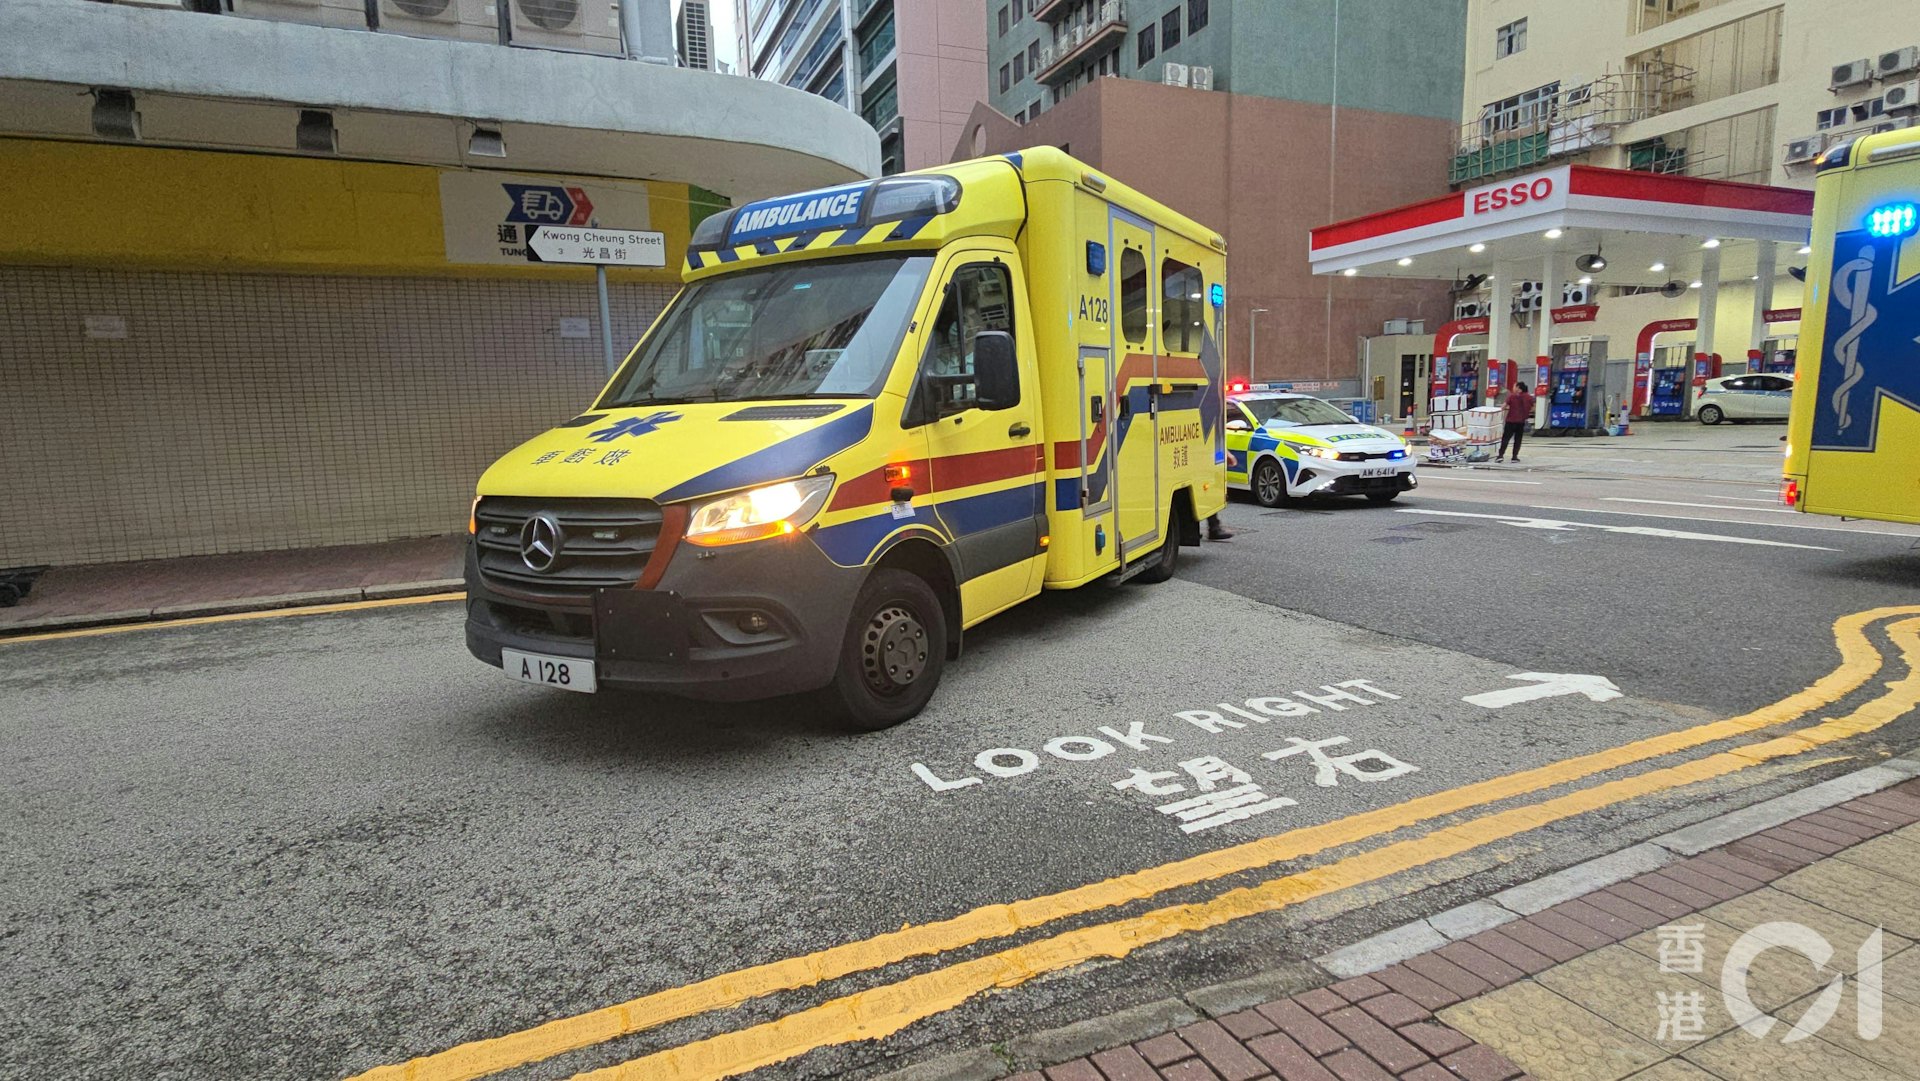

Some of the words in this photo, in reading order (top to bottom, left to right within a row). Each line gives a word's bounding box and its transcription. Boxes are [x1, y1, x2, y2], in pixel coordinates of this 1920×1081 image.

[1474, 177, 1553, 214] ESSO
[734, 191, 863, 234] AMBULANCE
[497, 224, 518, 244] 通
[543, 230, 580, 242] Kwong
[584, 232, 625, 245] Cheung
[628, 234, 661, 245] Street
[582, 247, 627, 260] 光昌街
[1079, 294, 1108, 323] A128
[1160, 422, 1199, 445] AMBULANCE
[1362, 468, 1373, 477] AM
[1376, 467, 1395, 476] 6414
[521, 658, 531, 679] A
[538, 660, 570, 685] 128
[910, 721, 1175, 792] LOOK
[1172, 678, 1402, 733] RIGHT
[1111, 735, 1421, 834] 望右
